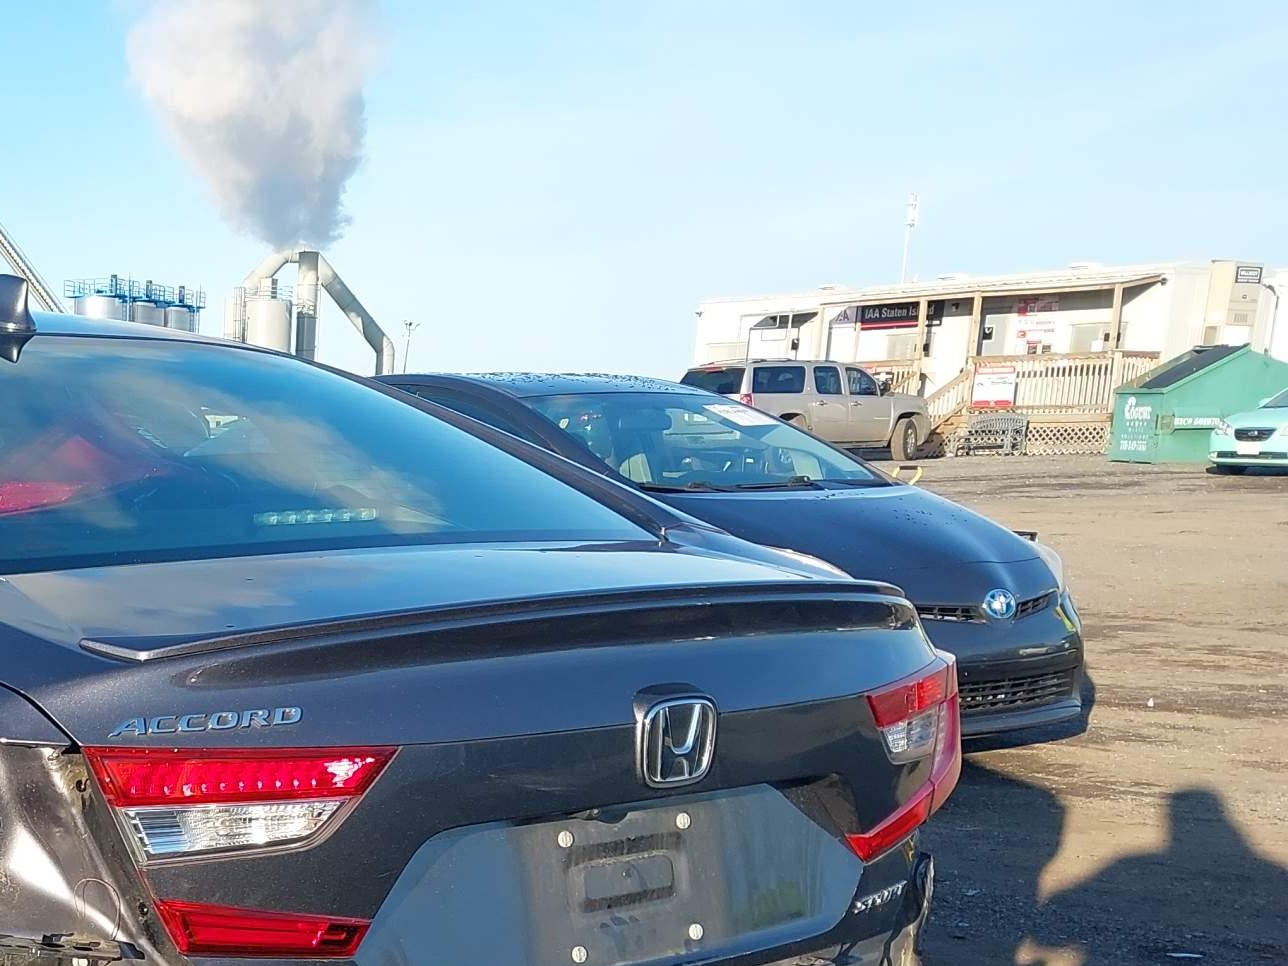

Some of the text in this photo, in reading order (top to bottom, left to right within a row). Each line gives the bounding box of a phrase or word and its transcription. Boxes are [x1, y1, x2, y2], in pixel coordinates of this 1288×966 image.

[865, 308, 880, 319] IAA
[881, 304, 907, 318] Staten
[108, 706, 303, 738] ACCORD
